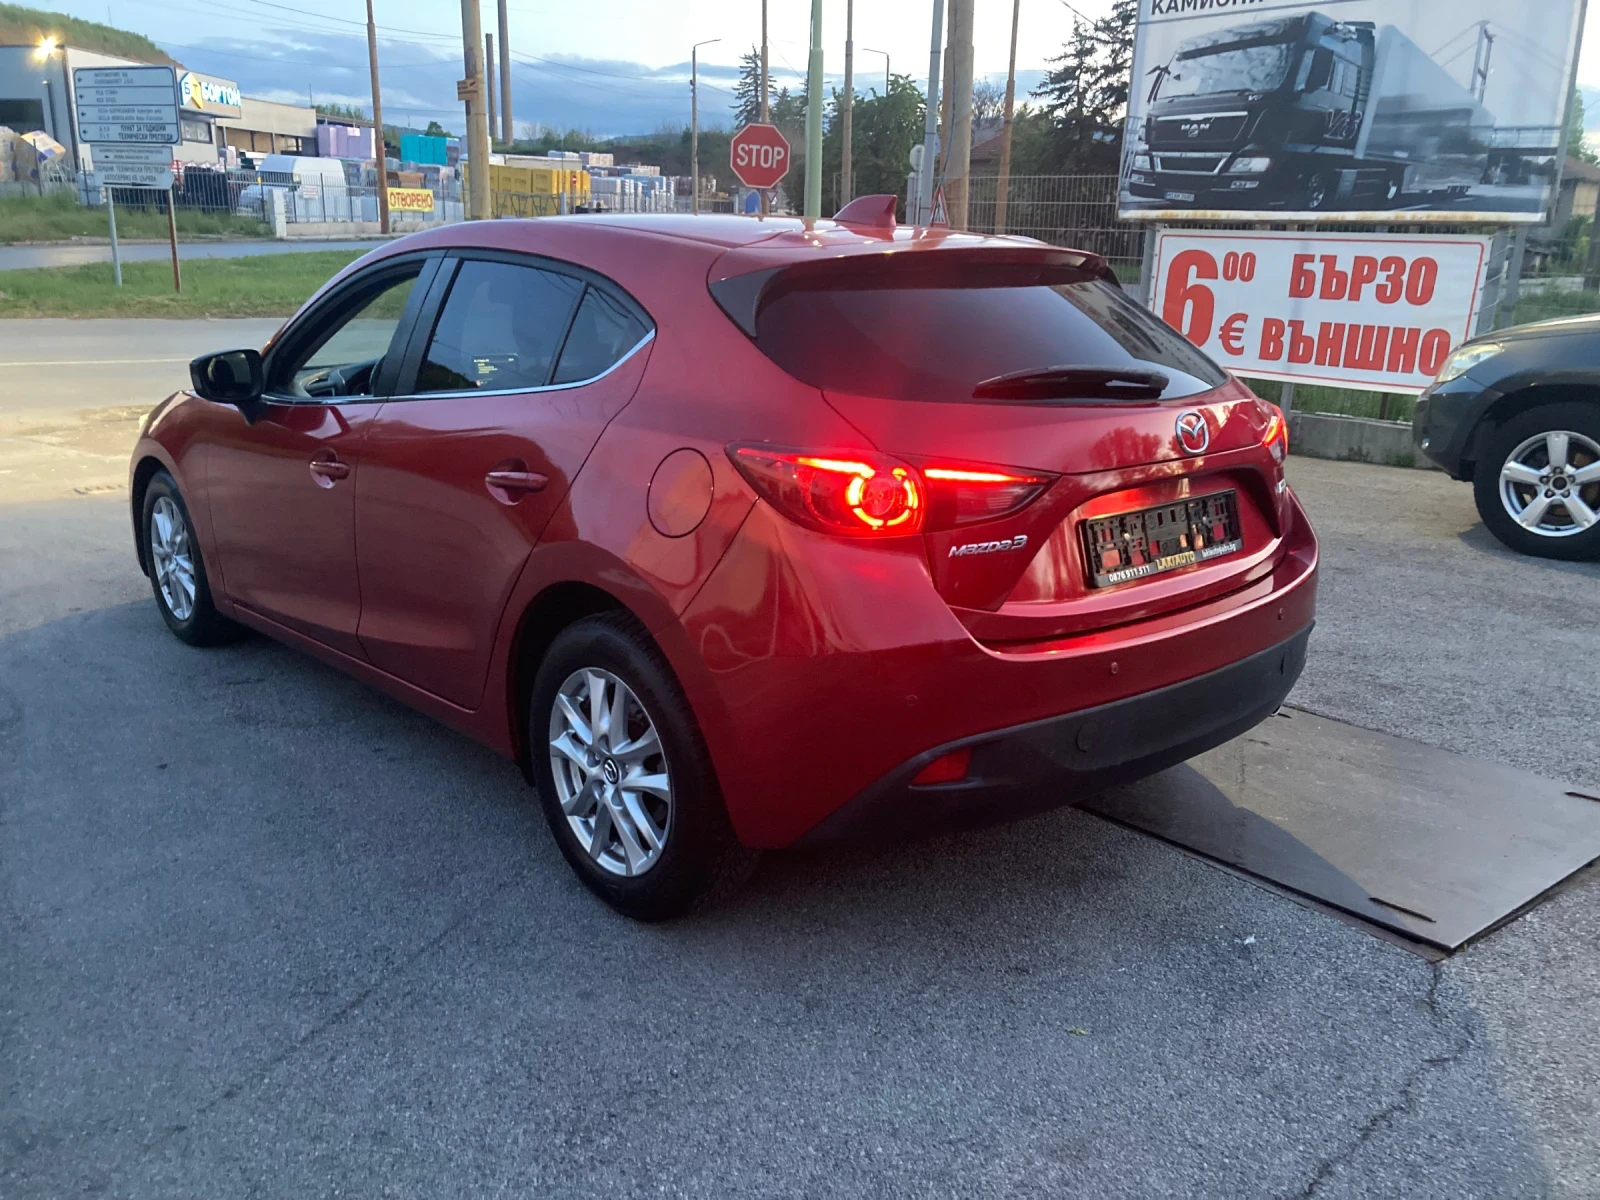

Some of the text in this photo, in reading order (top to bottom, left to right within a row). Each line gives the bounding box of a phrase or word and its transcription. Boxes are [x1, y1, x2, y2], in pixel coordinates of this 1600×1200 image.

[736, 143, 785, 169] STOP
[389, 191, 434, 209] ОТВОРЕНО
[1288, 253, 1439, 306] БЪРЗО
[1258, 317, 1451, 377] ВЪНШНО
